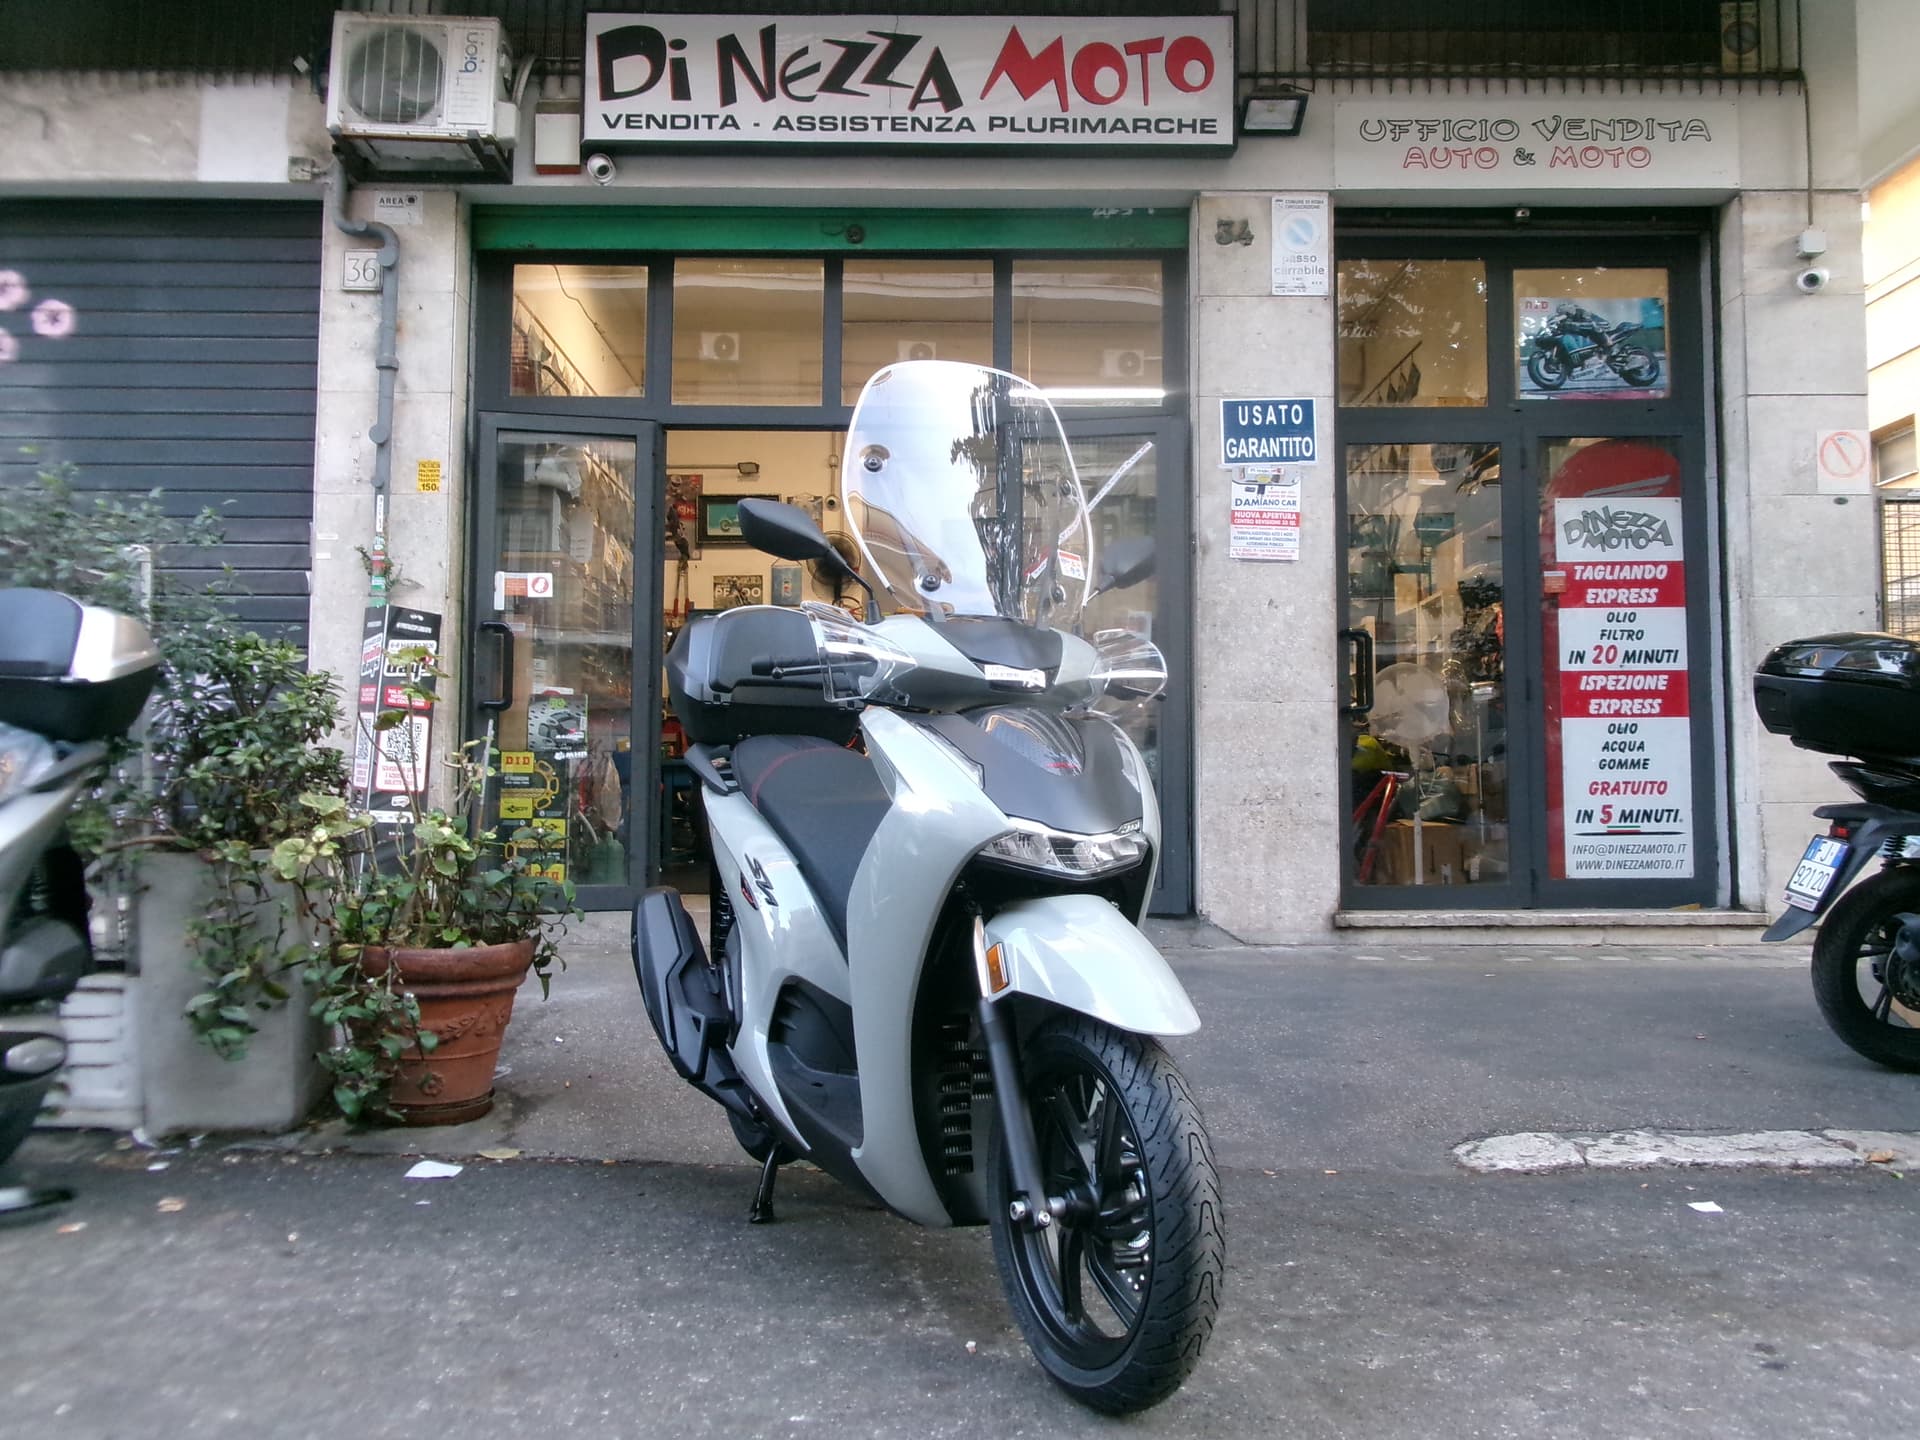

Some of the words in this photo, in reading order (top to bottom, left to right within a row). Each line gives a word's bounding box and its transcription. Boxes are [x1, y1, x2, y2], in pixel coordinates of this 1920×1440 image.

[596, 24, 692, 102] Di
[980, 23, 1215, 113] MOTO
[602, 113, 741, 131] VENDITA
[772, 114, 977, 133] ASSISTENZA
[988, 115, 1218, 135] PLURIMARCHE
[1359, 118, 1520, 143] UFFICIO
[1531, 114, 1712, 143] VENDITA
[1402, 146, 1500, 170] AUTO
[1513, 147, 1536, 166] &
[1549, 145, 1652, 169] MOTO
[379, 197, 405, 205] AREA
[346, 257, 377, 282] 36
[1238, 403, 1304, 426] USATO
[1226, 436, 1314, 459] GARANTITO
[1235, 498, 1280, 507] DAMIANO
[1234, 511, 1260, 519] NUOVA
[1262, 512, 1298, 520] APERTURA
[1582, 527, 1652, 553] MOTO
[1573, 564, 1669, 581] TAGLIANDO
[1585, 588, 1660, 605] EXPRESS
[1606, 611, 1637, 623] OLIO
[1599, 629, 1645, 641] FILTRO
[1568, 649, 1586, 665] IN
[1591, 644, 1619, 665] 20
[1621, 649, 1679, 665] MINUTI
[1579, 674, 1670, 691] ISPEZIONE
[1588, 698, 1663, 715] EXPRESS
[1607, 722, 1639, 735] OLIO
[1601, 740, 1646, 753] ACQUA
[1598, 758, 1651, 770] GOMME
[1588, 780, 1669, 797] GRATUITO
[1575, 809, 1594, 824] IN
[1599, 804, 1614, 825] 5
[1572, 843, 1688, 856] INFO@DINEZZAMOTO.IT
[1575, 859, 1685, 871] WWW.DINEZZAMOTO.IT
[1792, 865, 1831, 893] 92120
